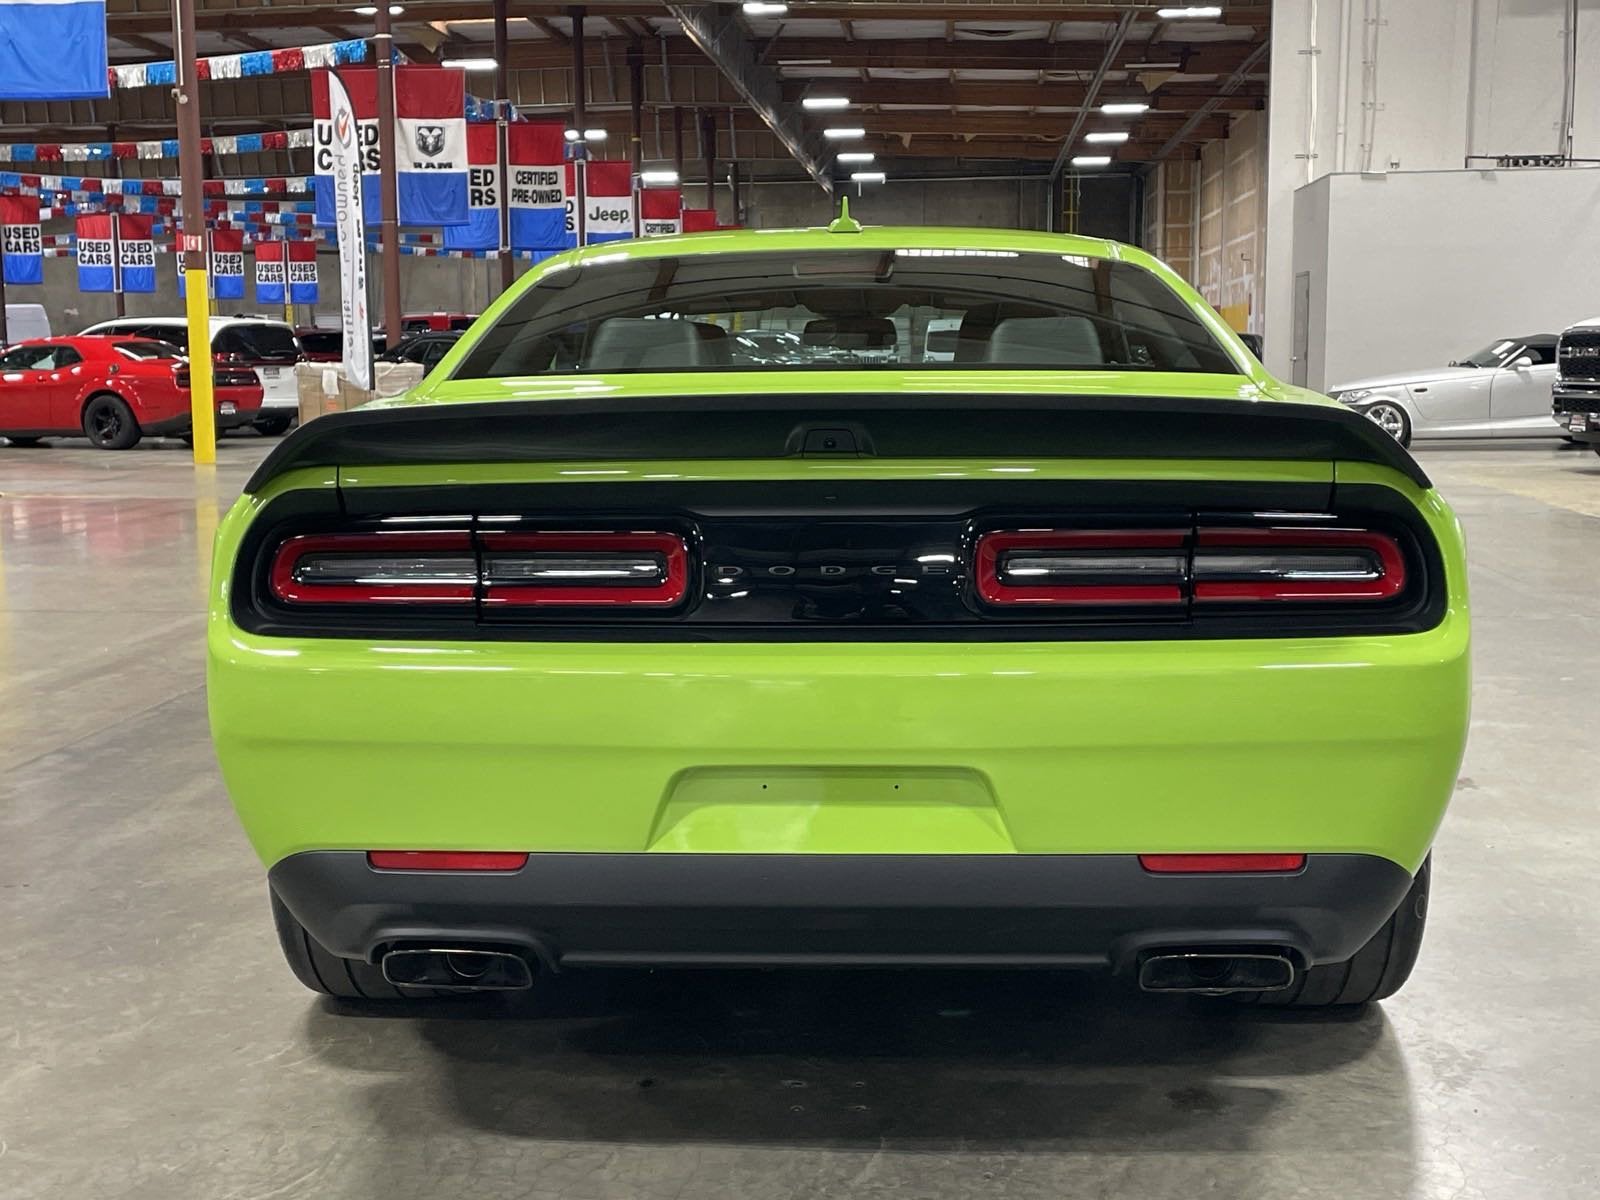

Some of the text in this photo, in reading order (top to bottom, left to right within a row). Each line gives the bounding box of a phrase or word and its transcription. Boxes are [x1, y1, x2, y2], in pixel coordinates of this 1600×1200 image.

[469, 168, 495, 187] ED
[515, 170, 558, 185] CERTIFIED
[470, 188, 497, 207] RS
[511, 188, 562, 204] PRE-OWNED
[588, 206, 629, 223] Jeep
[3, 226, 40, 239] USED
[5, 240, 41, 253] CARS
[78, 241, 111, 253] USED
[121, 242, 151, 253] USED
[79, 253, 112, 265] CARS
[121, 254, 153, 265] CARS
[214, 253, 242, 264] USED
[214, 264, 243, 274] CARS
[257, 263, 283, 273] USED
[290, 263, 316, 273] USED
[257, 273, 284, 283] CARS
[290, 273, 317, 283] CARS
[717, 565, 949, 576] DODGE
